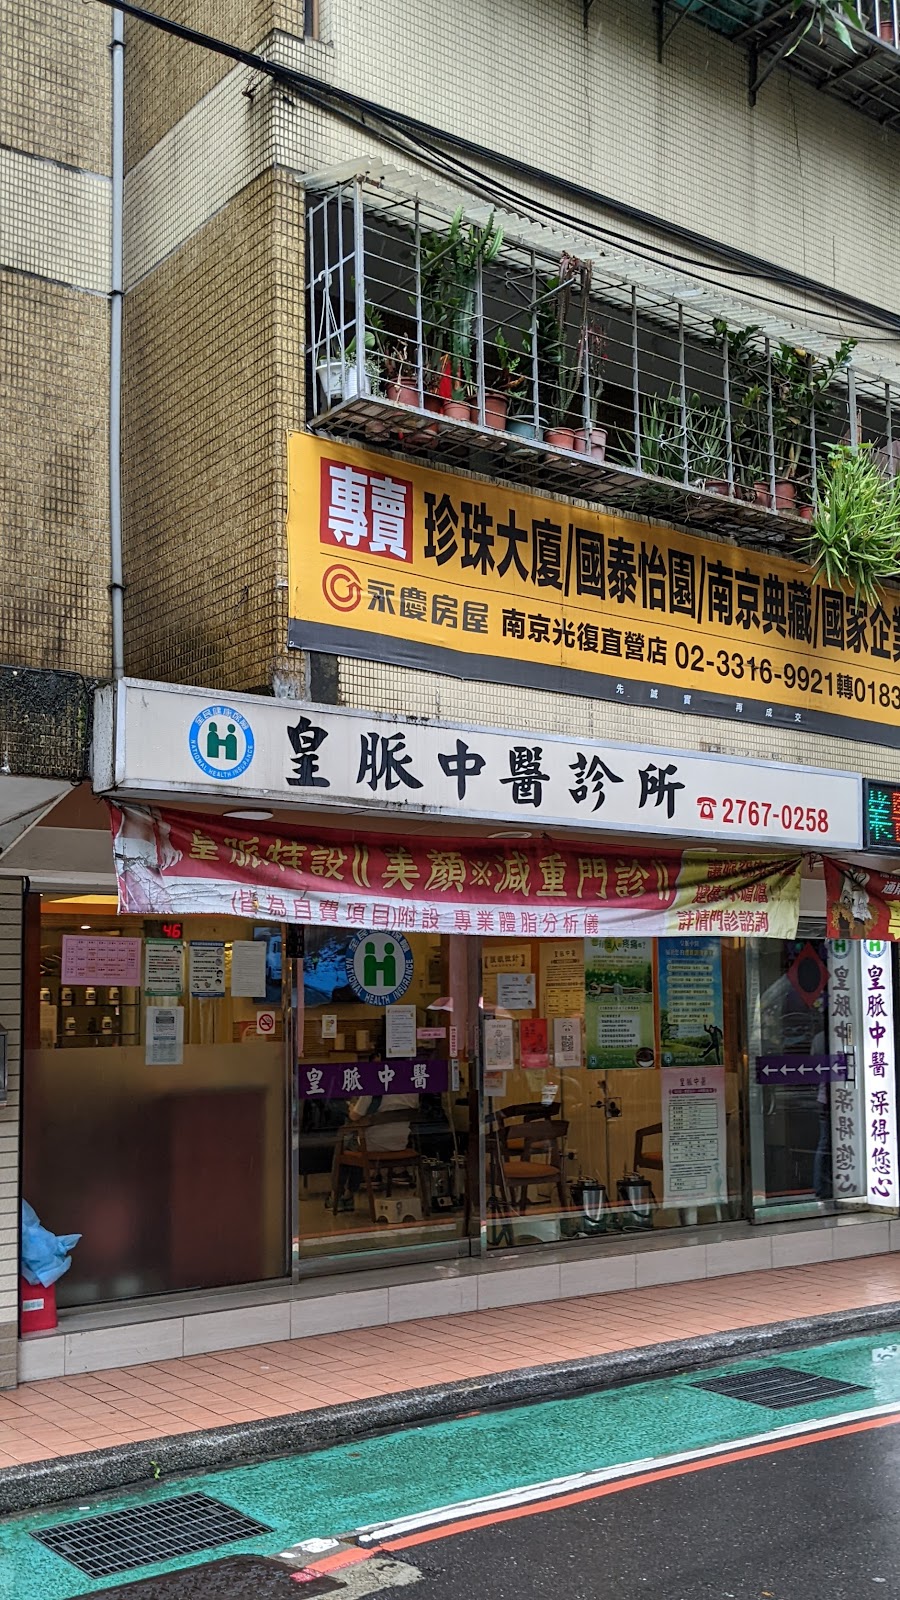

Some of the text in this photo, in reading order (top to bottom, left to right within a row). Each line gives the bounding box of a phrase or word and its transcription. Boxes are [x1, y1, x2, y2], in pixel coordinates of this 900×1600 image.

[328, 465, 407, 560] 專賣
[367, 578, 488, 634] 永慶房屋
[502, 608, 667, 666] 南京光復直營店
[286, 716, 829, 833] 皇脈中醫診所 2767-0258
[162, 924, 181, 938] 46
[345, 957, 415, 1006] NATIONAL HEALTH INSURANCE
[866, 964, 889, 1078] 皇脈中醫
[305, 1063, 431, 1095] 皇脈中醫
[870, 1090, 893, 1198] 深得您心
